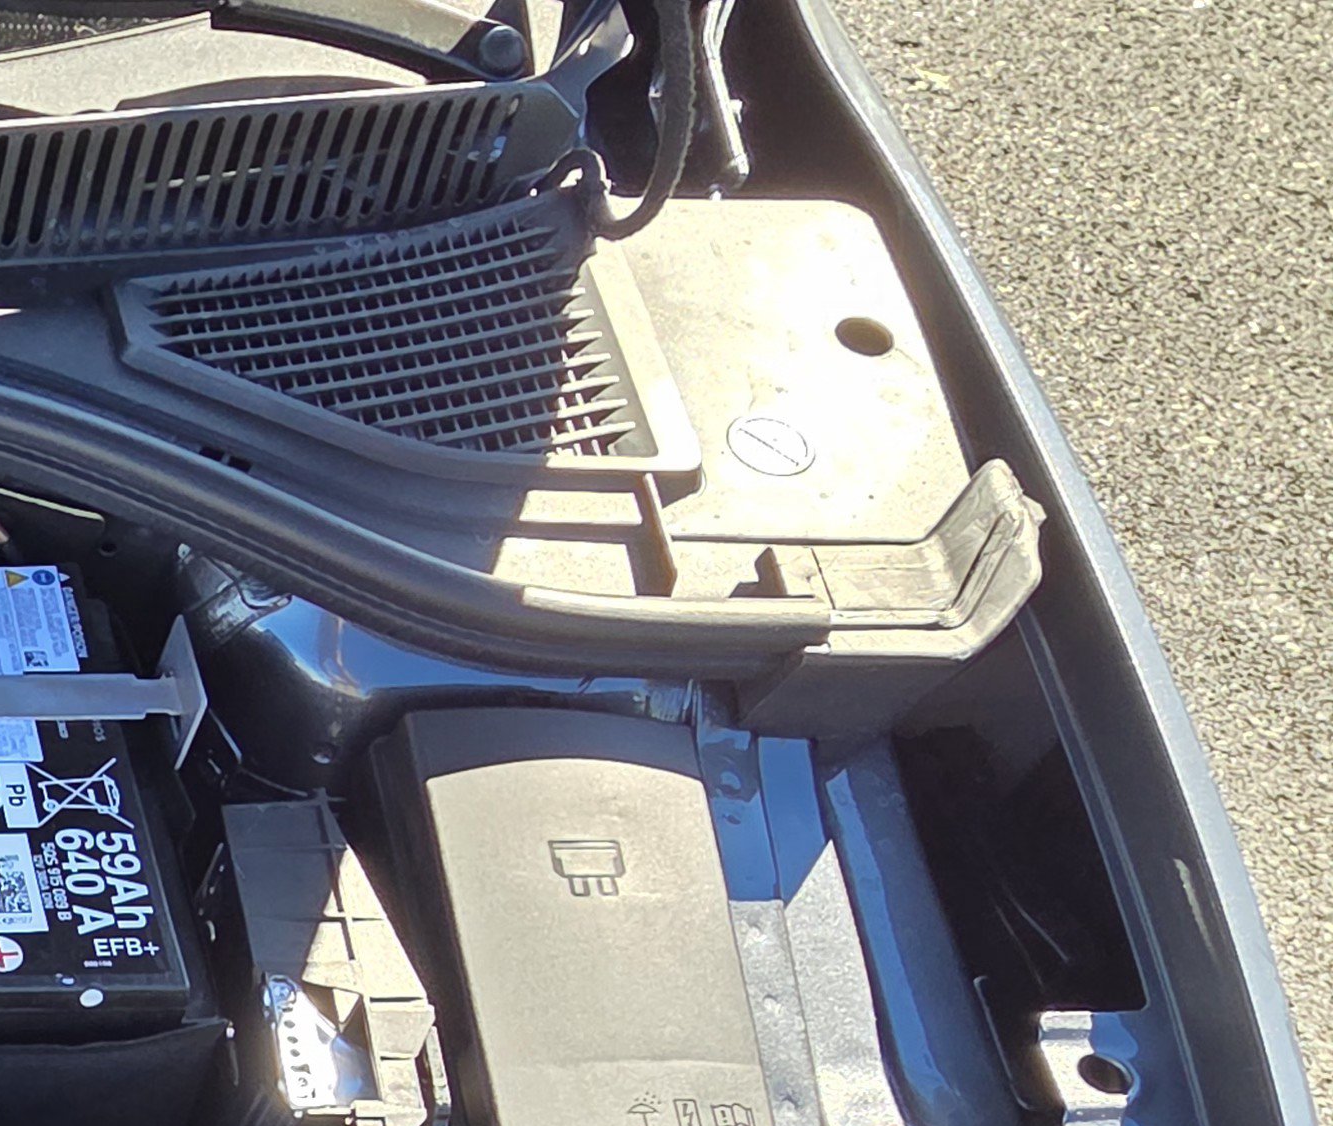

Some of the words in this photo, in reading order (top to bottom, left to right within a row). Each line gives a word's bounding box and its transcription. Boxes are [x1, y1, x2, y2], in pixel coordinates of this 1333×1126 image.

[5, 783, 27, 807] Pb
[54, 828, 106, 896] 640
[95, 830, 154, 929] 59Ah
[71, 904, 115, 935] A
[93, 937, 160, 957] EFB+
